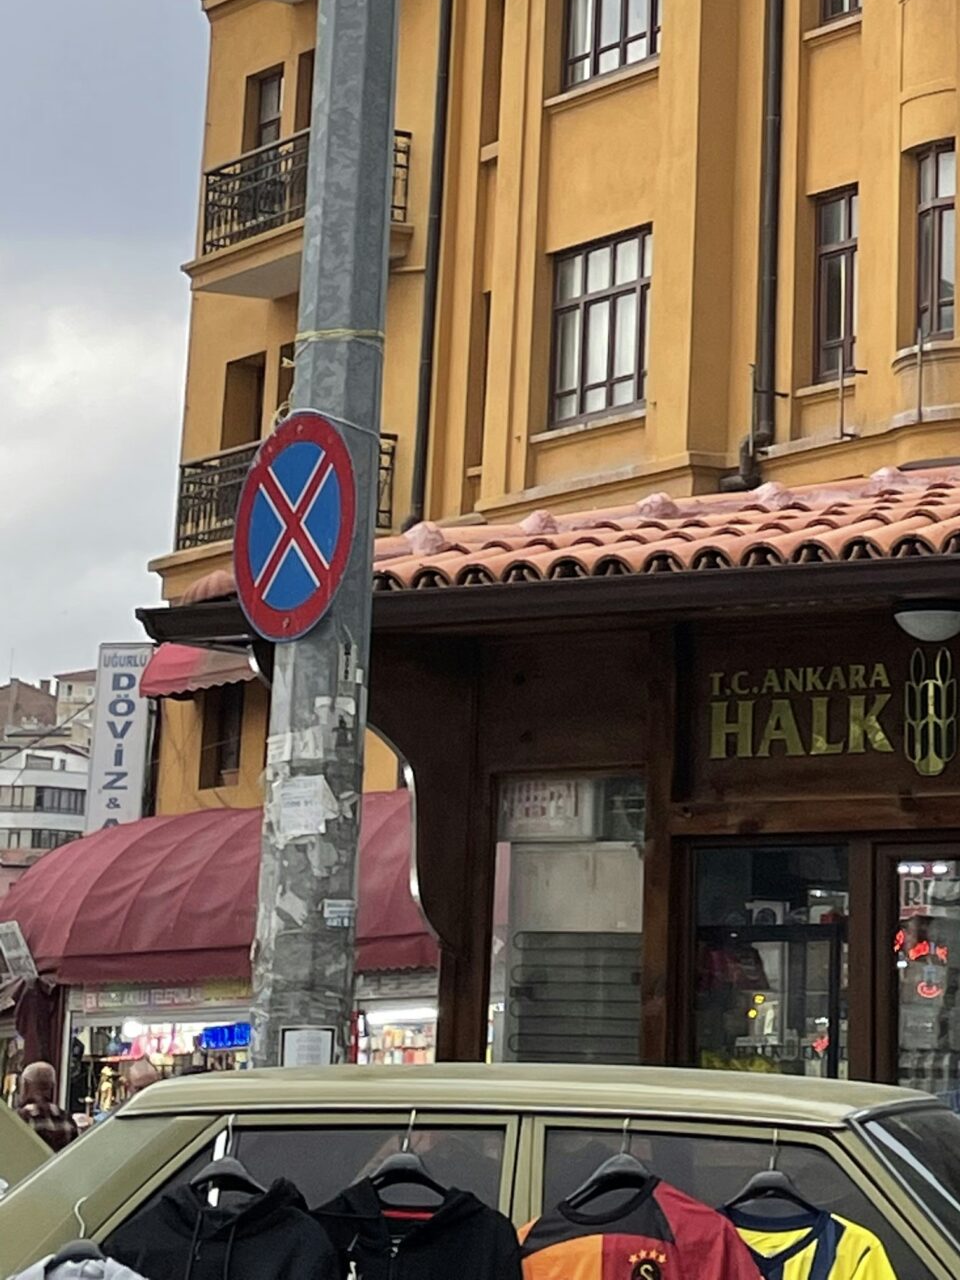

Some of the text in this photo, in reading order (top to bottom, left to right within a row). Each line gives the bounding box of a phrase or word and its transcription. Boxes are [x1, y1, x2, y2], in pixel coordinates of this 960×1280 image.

[103, 653, 148, 668] UĞURLU
[102, 673, 136, 790] DÖVİZ
[709, 693, 895, 759] HALK
